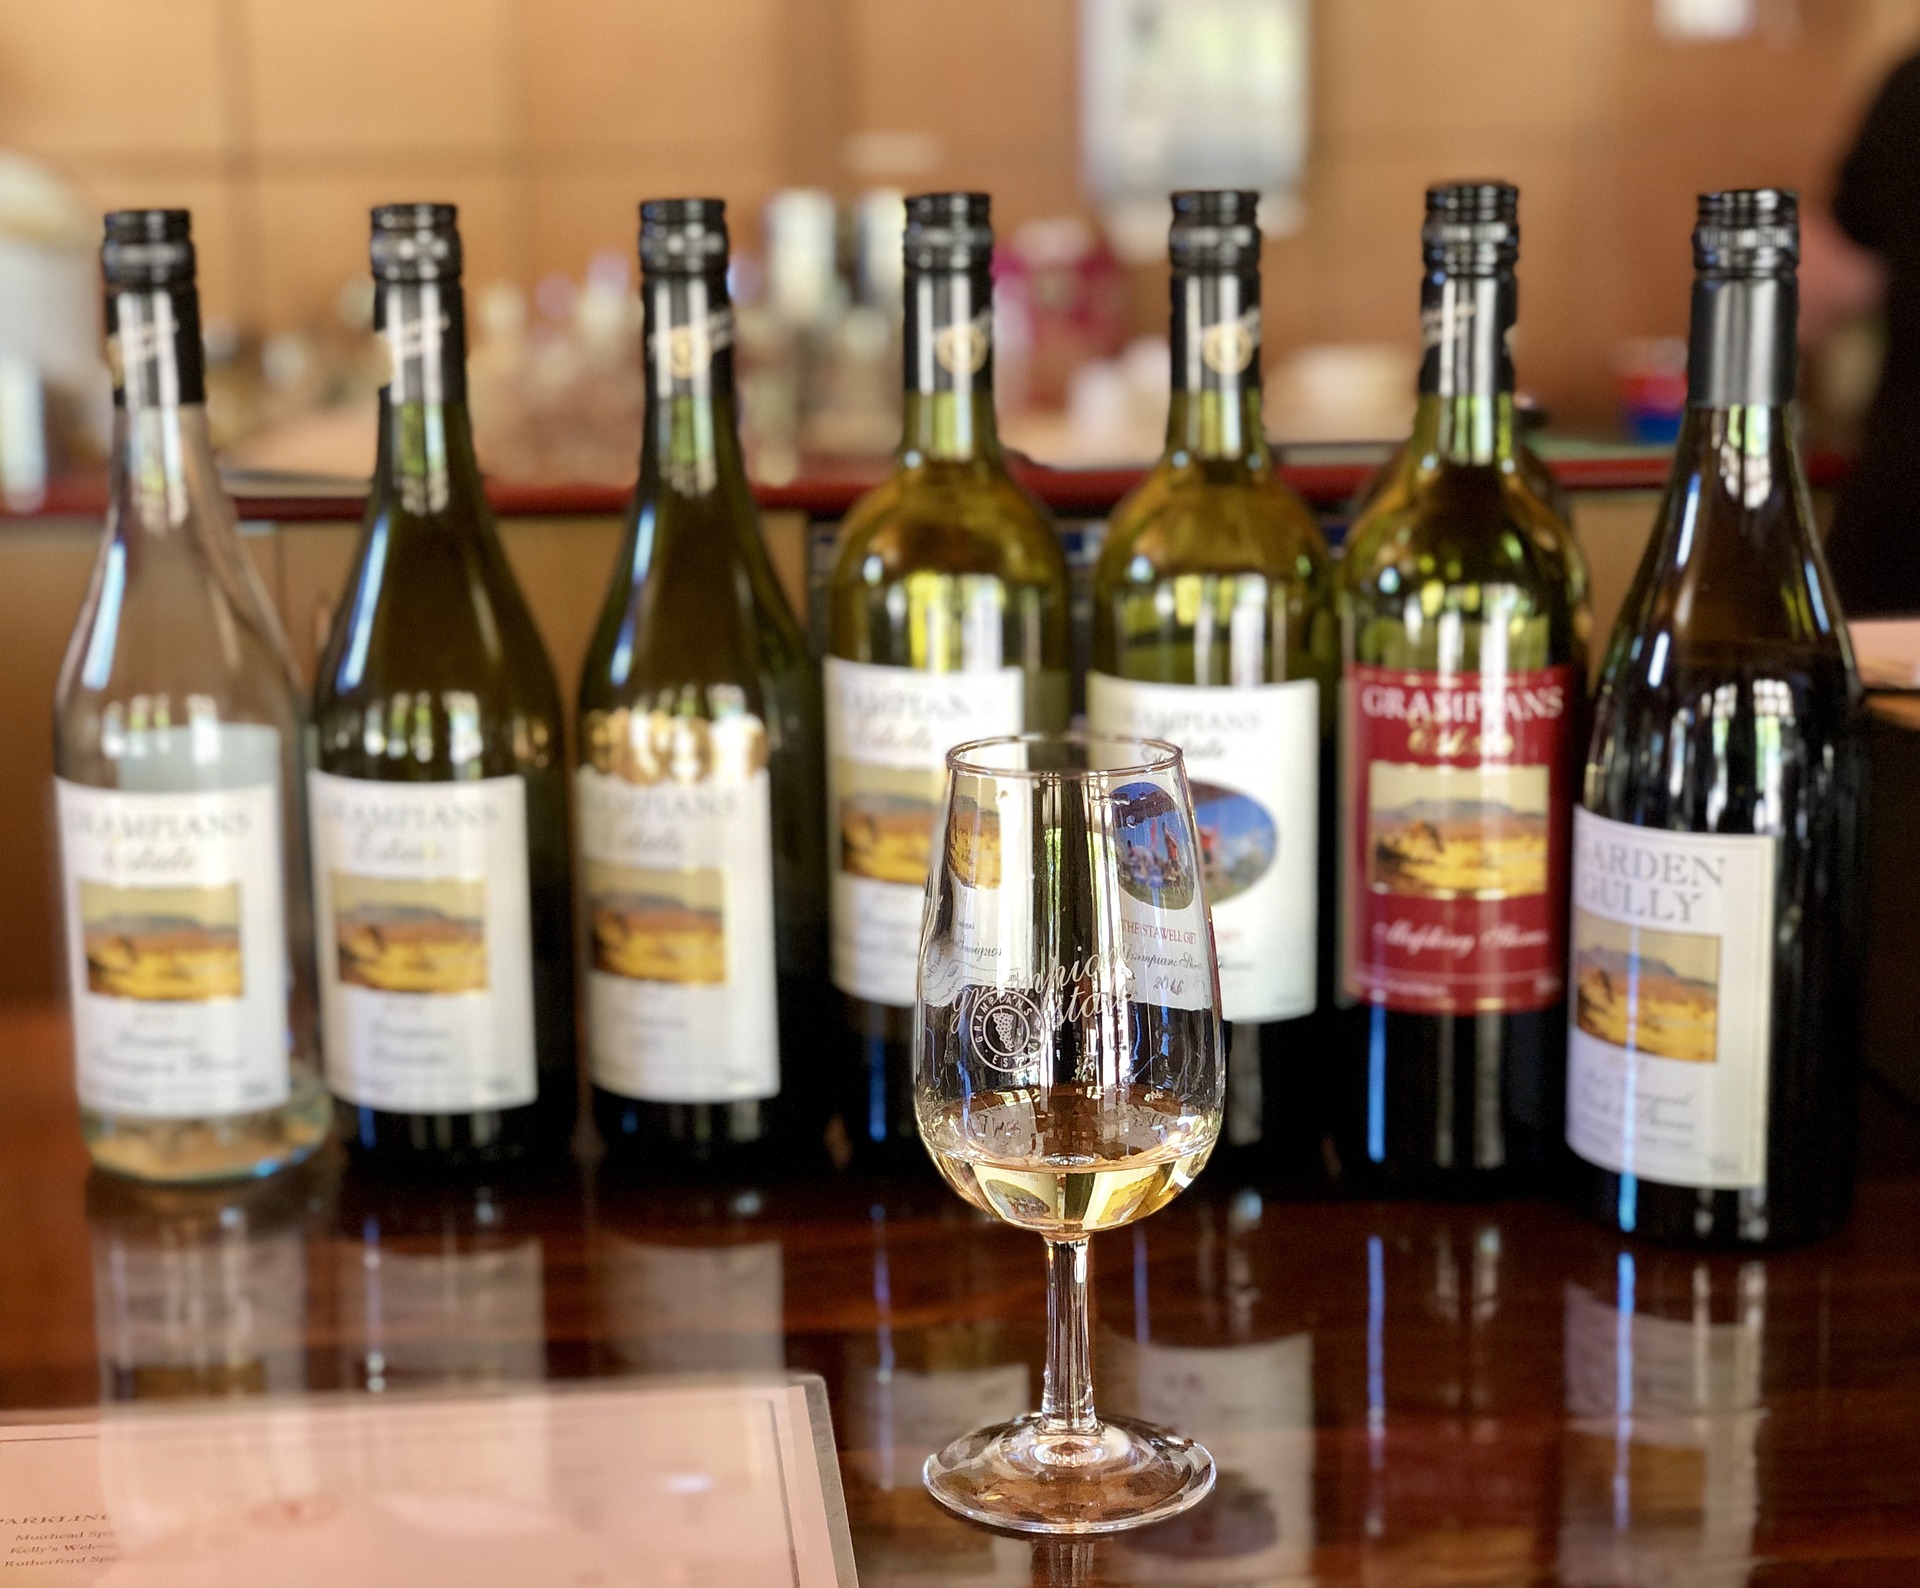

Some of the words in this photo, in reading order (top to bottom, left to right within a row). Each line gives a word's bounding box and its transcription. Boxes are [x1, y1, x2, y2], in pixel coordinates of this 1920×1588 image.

[1361, 685, 1564, 723] GRAMPANS
[1121, 918, 1139, 935] THE
[1141, 924, 1182, 943] STAWELL
